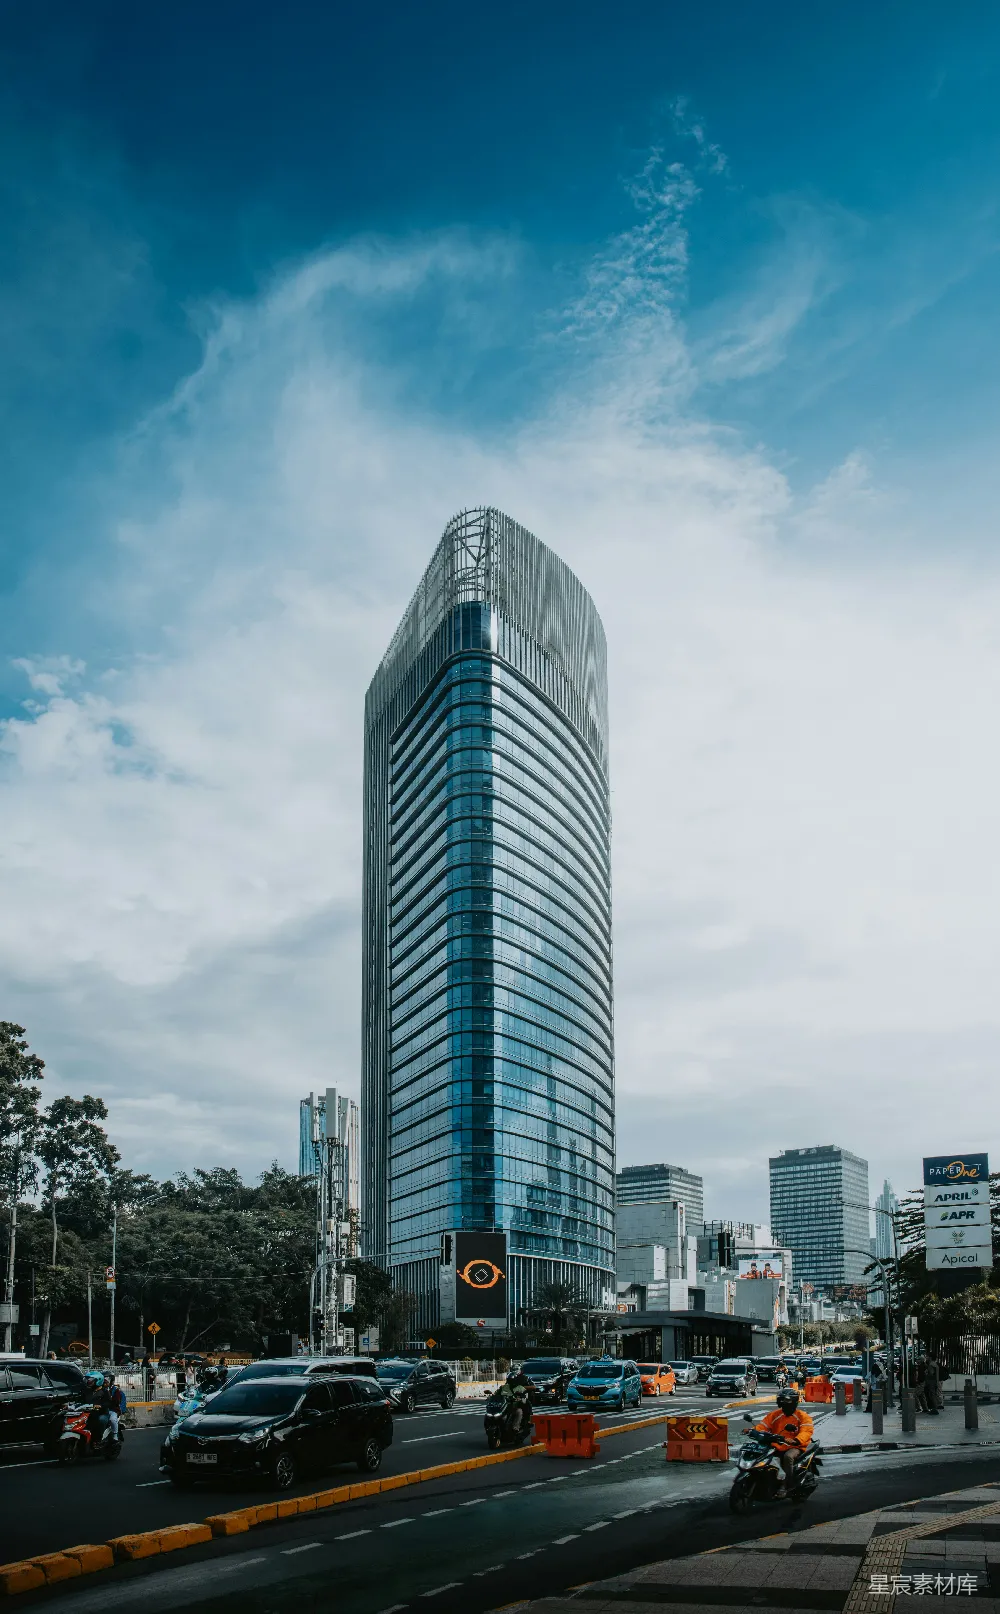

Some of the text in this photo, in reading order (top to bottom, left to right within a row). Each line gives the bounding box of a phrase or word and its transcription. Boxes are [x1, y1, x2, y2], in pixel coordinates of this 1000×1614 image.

[934, 1192, 972, 1202] APRIL
[948, 1210, 975, 1220] APR
[941, 1253, 978, 1266] Apical
